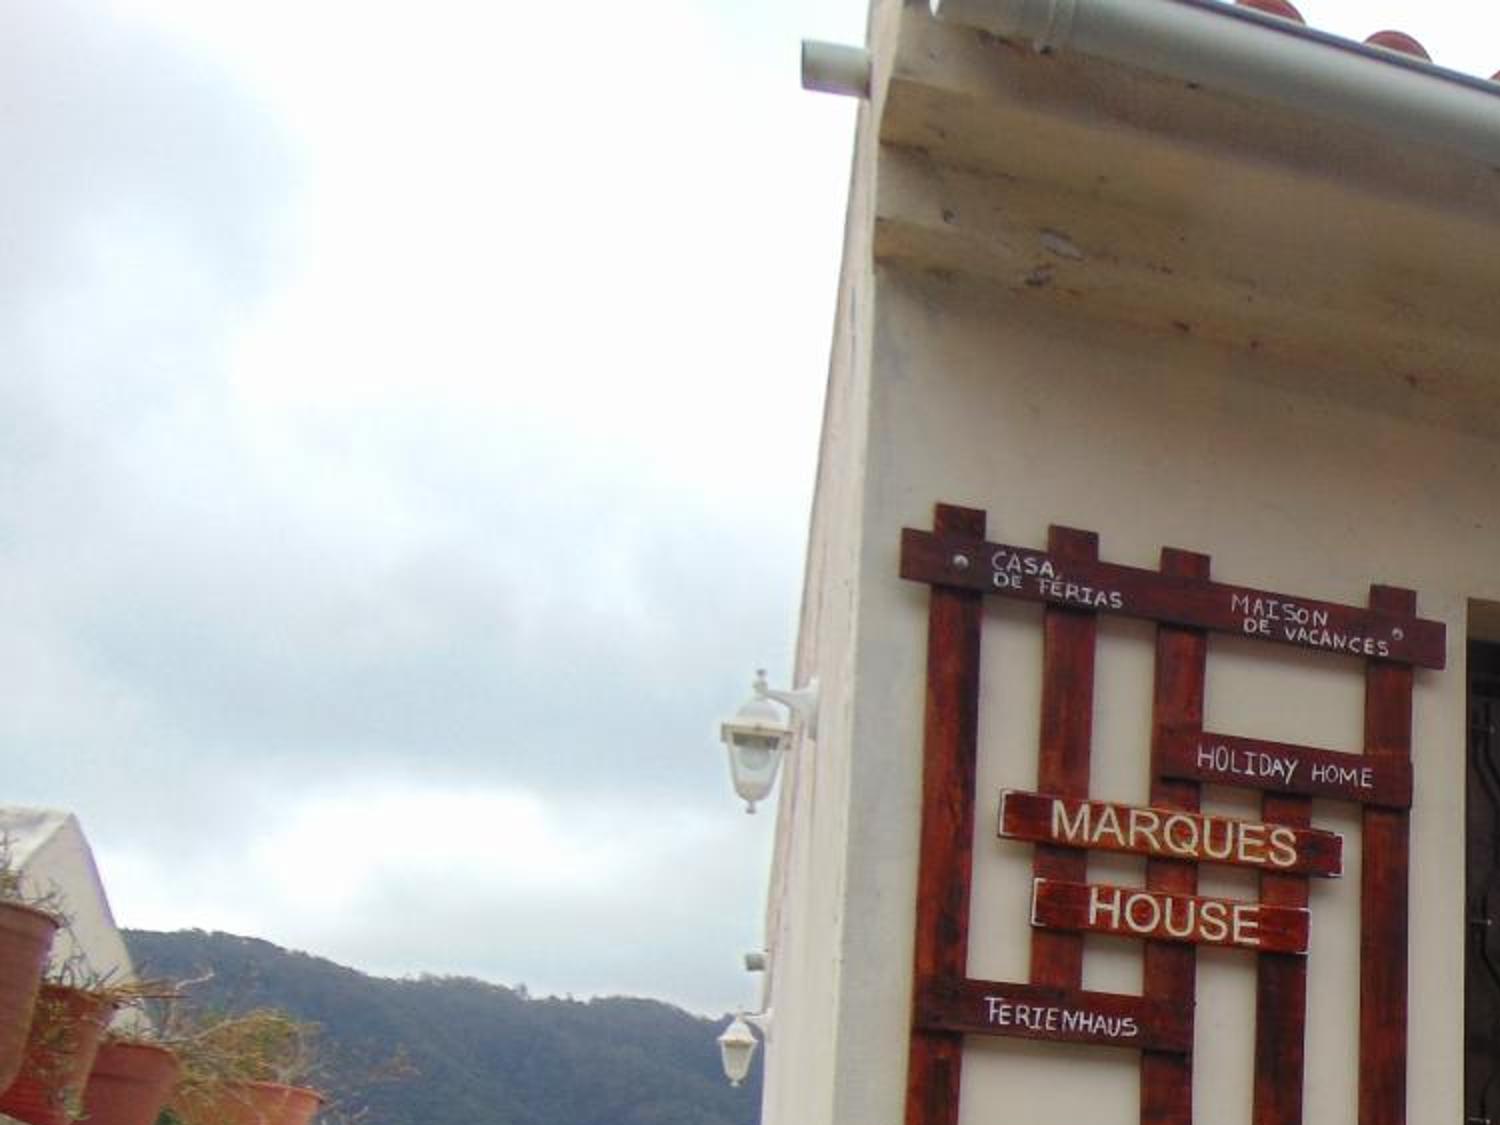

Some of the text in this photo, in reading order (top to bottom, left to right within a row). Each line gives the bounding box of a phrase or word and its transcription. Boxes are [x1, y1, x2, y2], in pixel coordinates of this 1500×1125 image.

[992, 551, 1055, 579] CASA
[993, 572, 1023, 589] DE
[1231, 594, 1328, 627] MAISON
[1243, 618, 1390, 657] DE VACANCES
[1197, 744, 1374, 789] HOLIDAY HOME
[1050, 799, 1298, 868] MARQUES
[1087, 887, 1262, 946] HOUSE
[984, 997, 1138, 1037] FERIENHAUS
